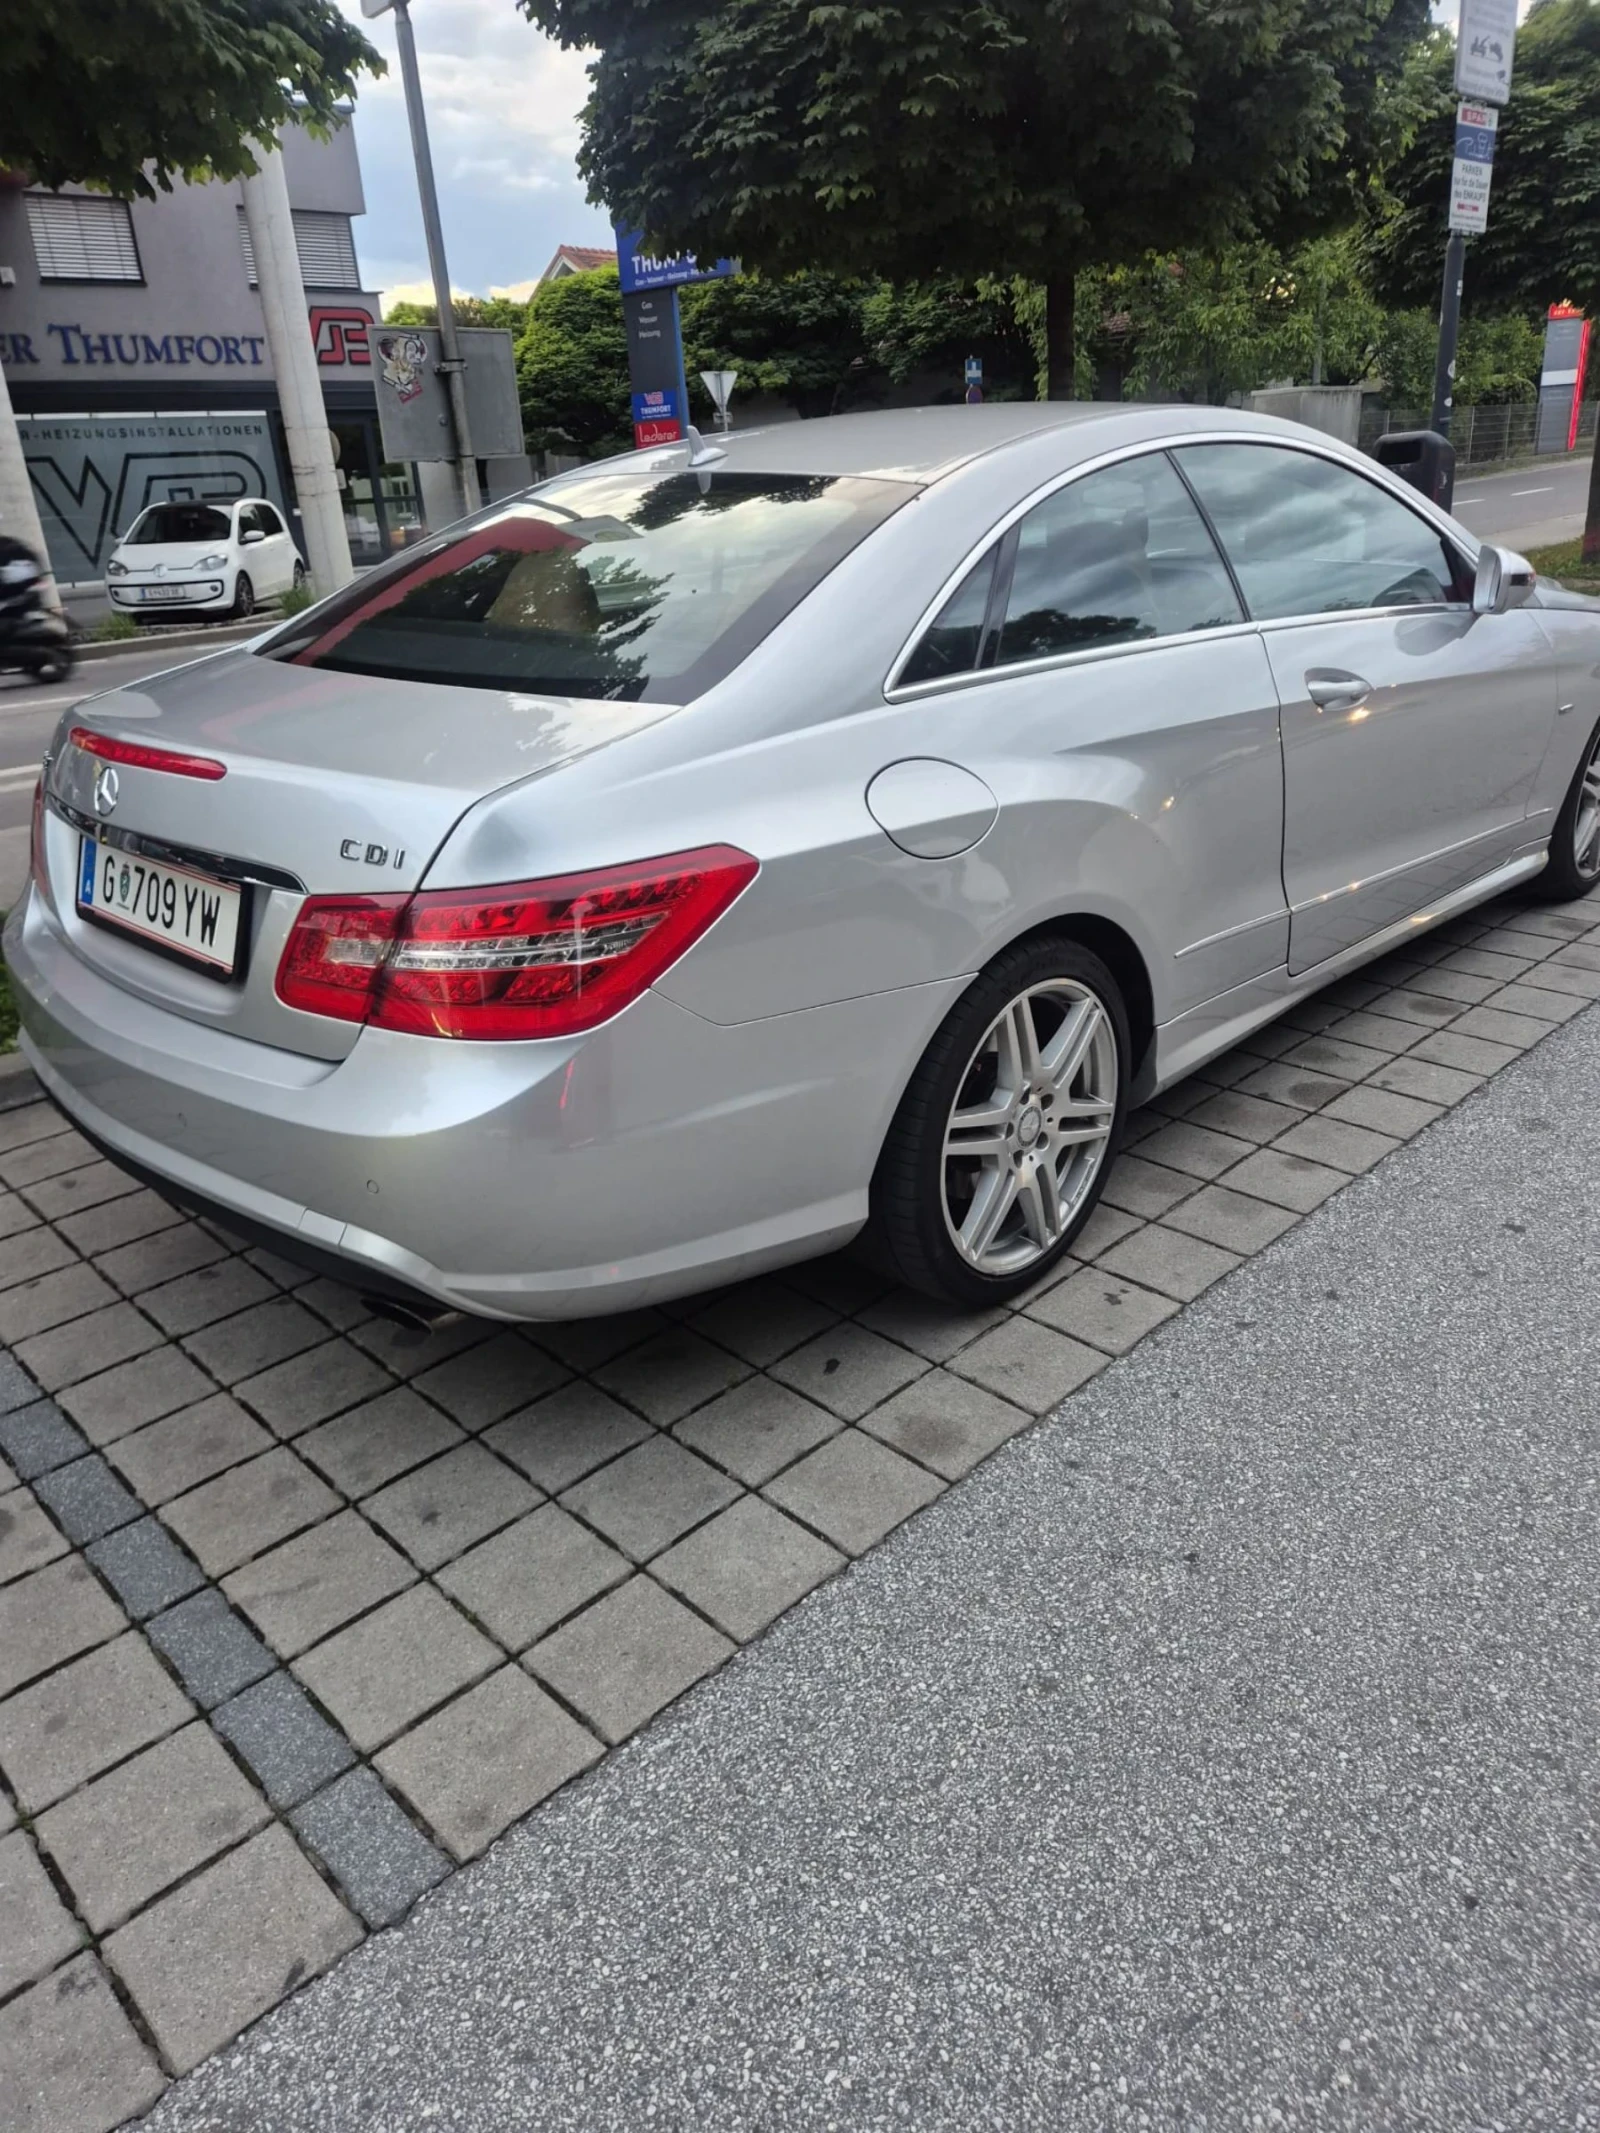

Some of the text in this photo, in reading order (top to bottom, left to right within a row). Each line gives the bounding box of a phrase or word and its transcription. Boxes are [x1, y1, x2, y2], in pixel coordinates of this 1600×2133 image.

[47, 323, 265, 366] THUMFORT
[340, 838, 406, 870] CDI
[84, 879, 92, 894] A
[102, 854, 116, 903] G
